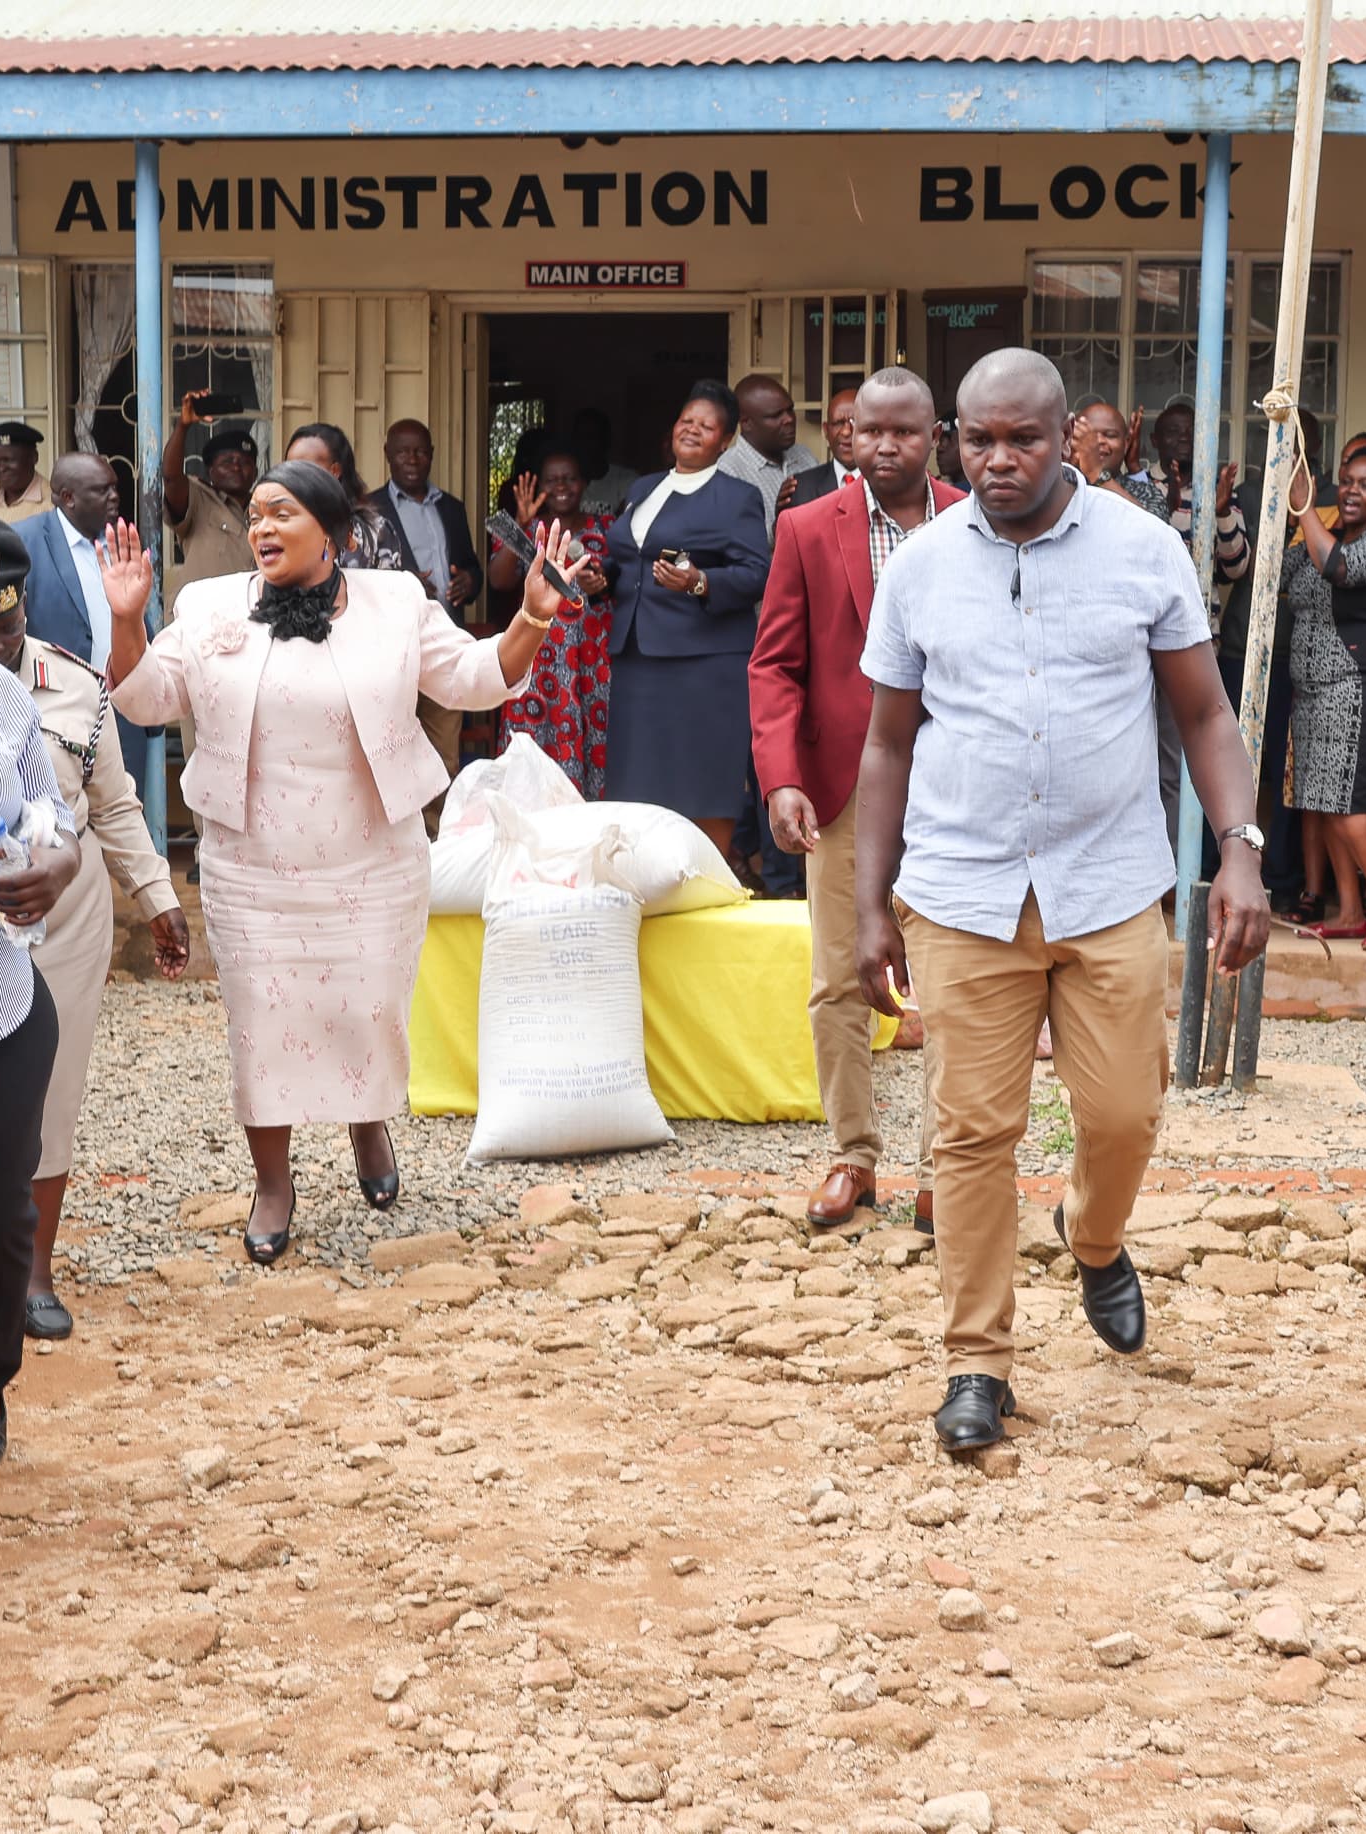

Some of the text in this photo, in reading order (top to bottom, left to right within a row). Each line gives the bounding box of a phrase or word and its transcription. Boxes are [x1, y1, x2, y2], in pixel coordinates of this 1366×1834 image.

[920, 161, 1243, 222] BLOCK
[530, 263, 680, 286] MAIN OFFICE
[927, 303, 999, 318] COMPLAINT
[810, 312, 866, 327] TNDER
[948, 314, 976, 328] BOX
[539, 921, 597, 944] BEANS
[571, 1089, 588, 1100] ANY
